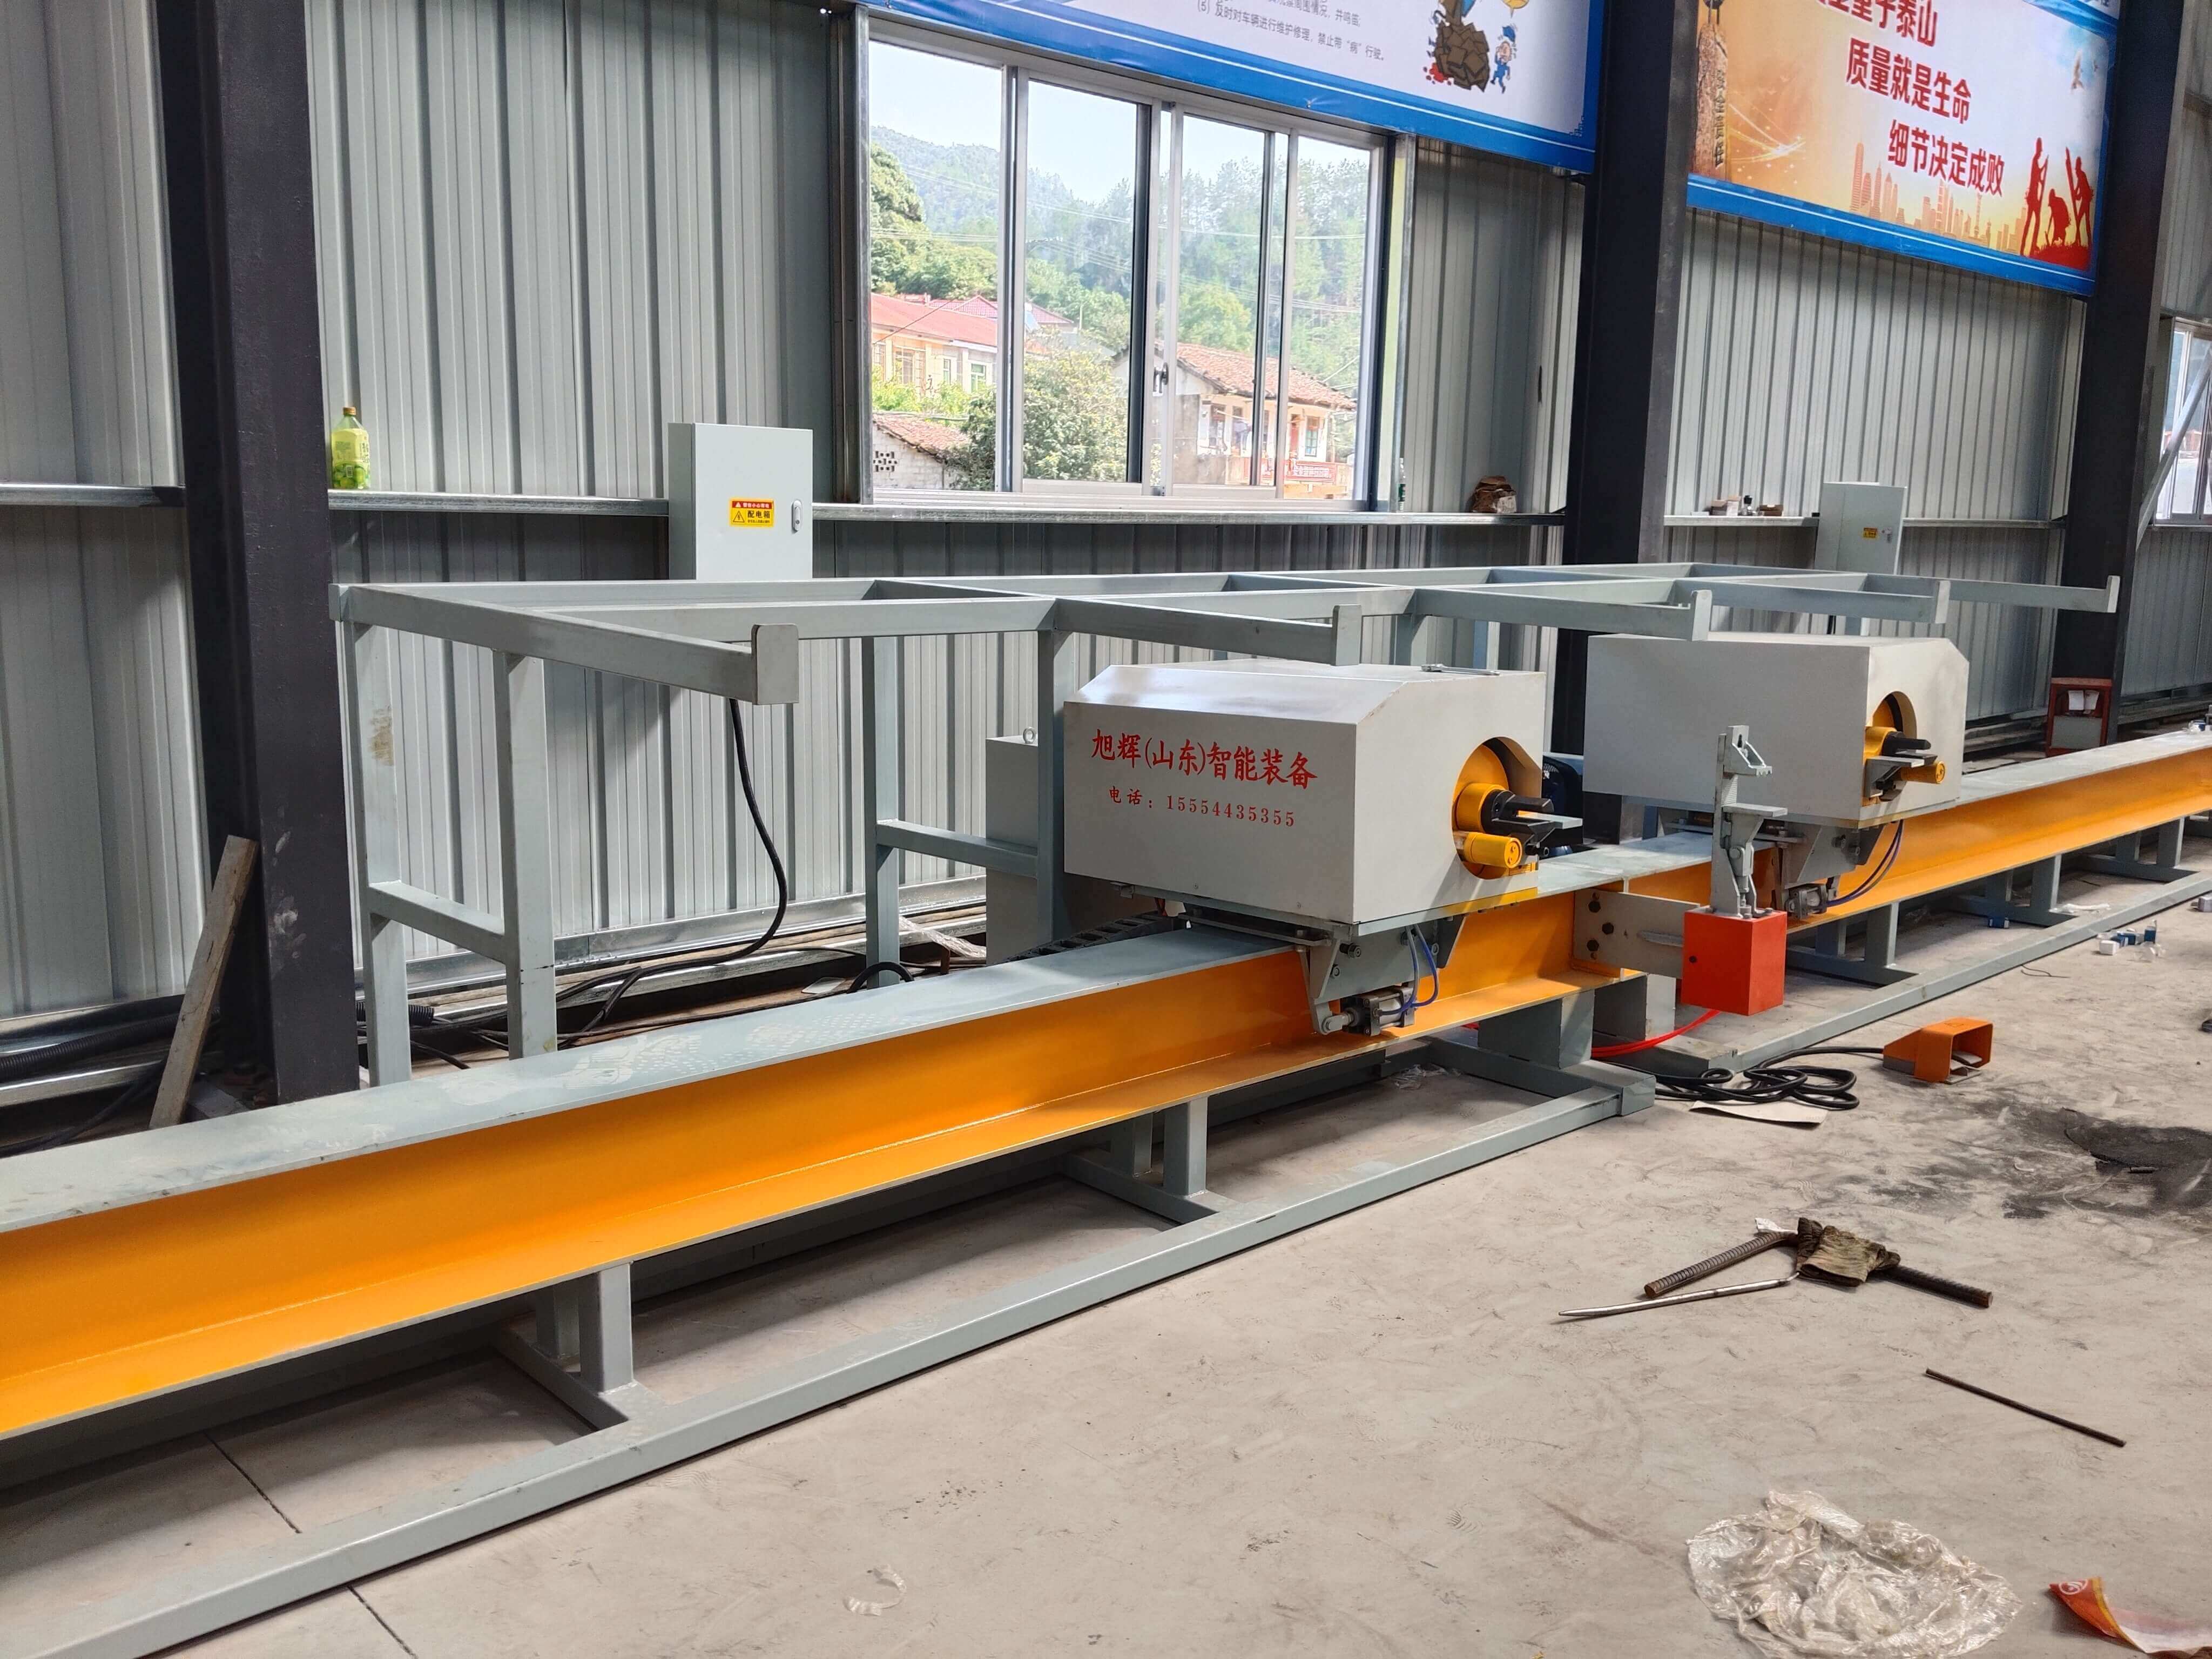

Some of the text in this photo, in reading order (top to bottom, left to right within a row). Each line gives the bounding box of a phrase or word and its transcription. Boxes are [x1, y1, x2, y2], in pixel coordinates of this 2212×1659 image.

[1818, 0, 1938, 47] 于泰山
[1846, 37, 1971, 124] 质量就是生命
[1888, 119, 2005, 197] 细节决定成败
[747, 510, 771, 519] 配电箱
[1091, 729, 1318, 790] 旭辉(山东)智能装备
